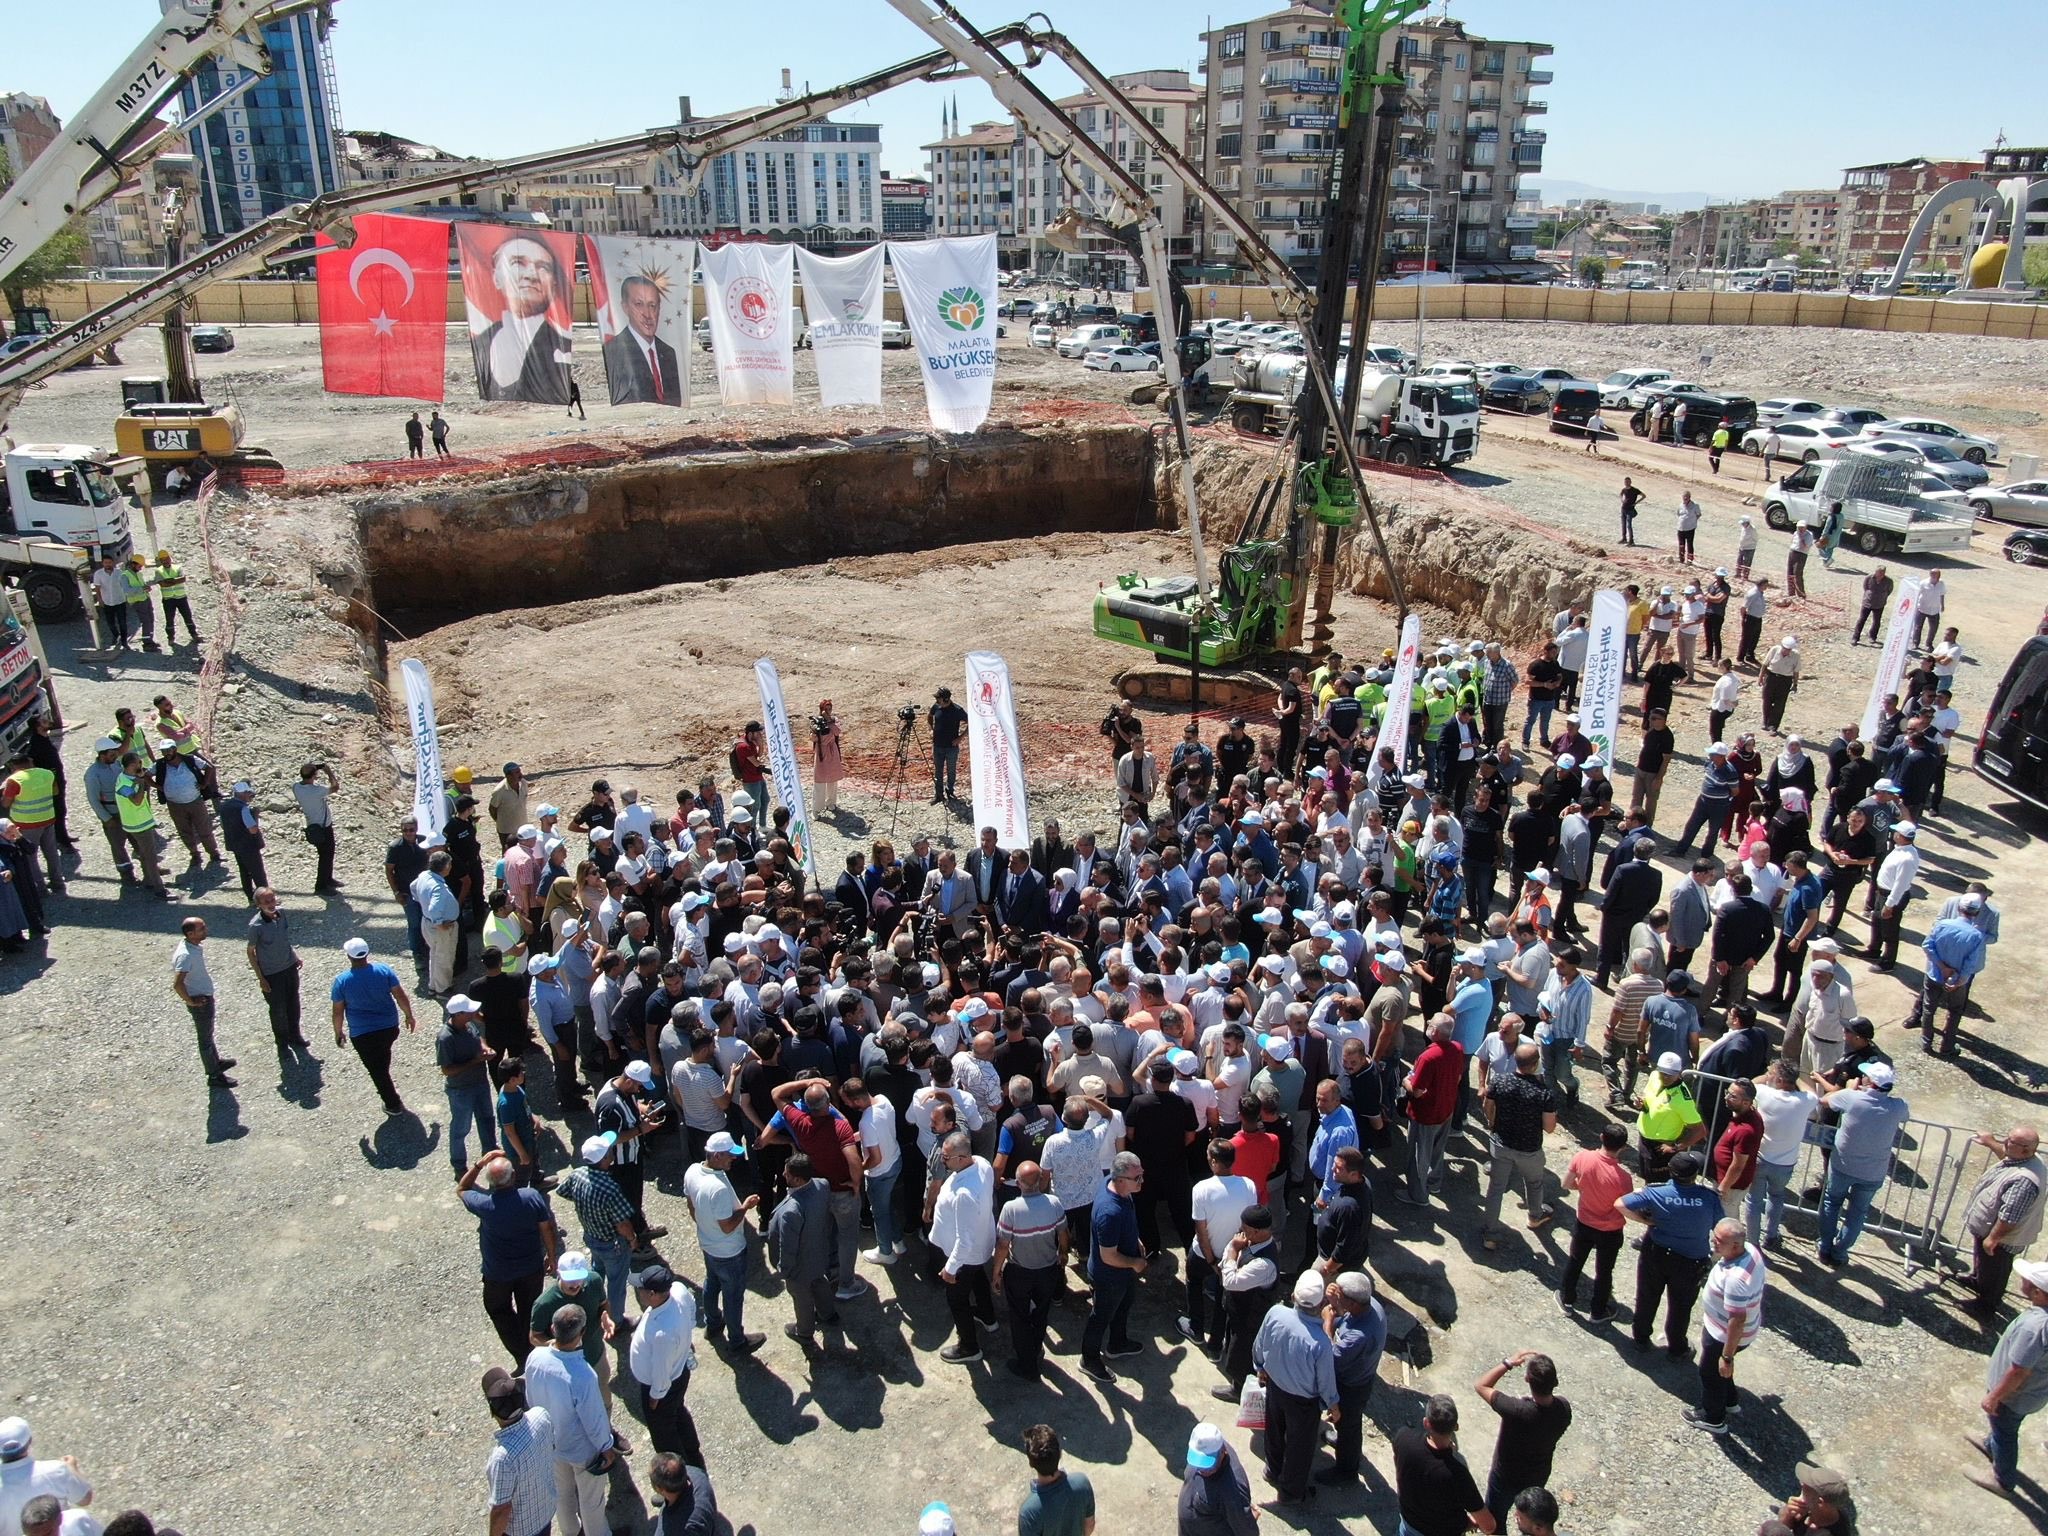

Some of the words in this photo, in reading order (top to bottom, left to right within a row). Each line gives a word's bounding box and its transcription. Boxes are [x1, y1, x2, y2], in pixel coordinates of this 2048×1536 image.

[224, 73, 255, 198] arasya
[1000, 239, 1017, 247] RKET
[948, 338, 991, 351] MALATYA
[928, 350, 995, 370] BÜYÜKŞEH
[954, 367, 994, 380] BELEDİYES
[153, 430, 189, 451] CAT
[2, 646, 30, 678] BETON
